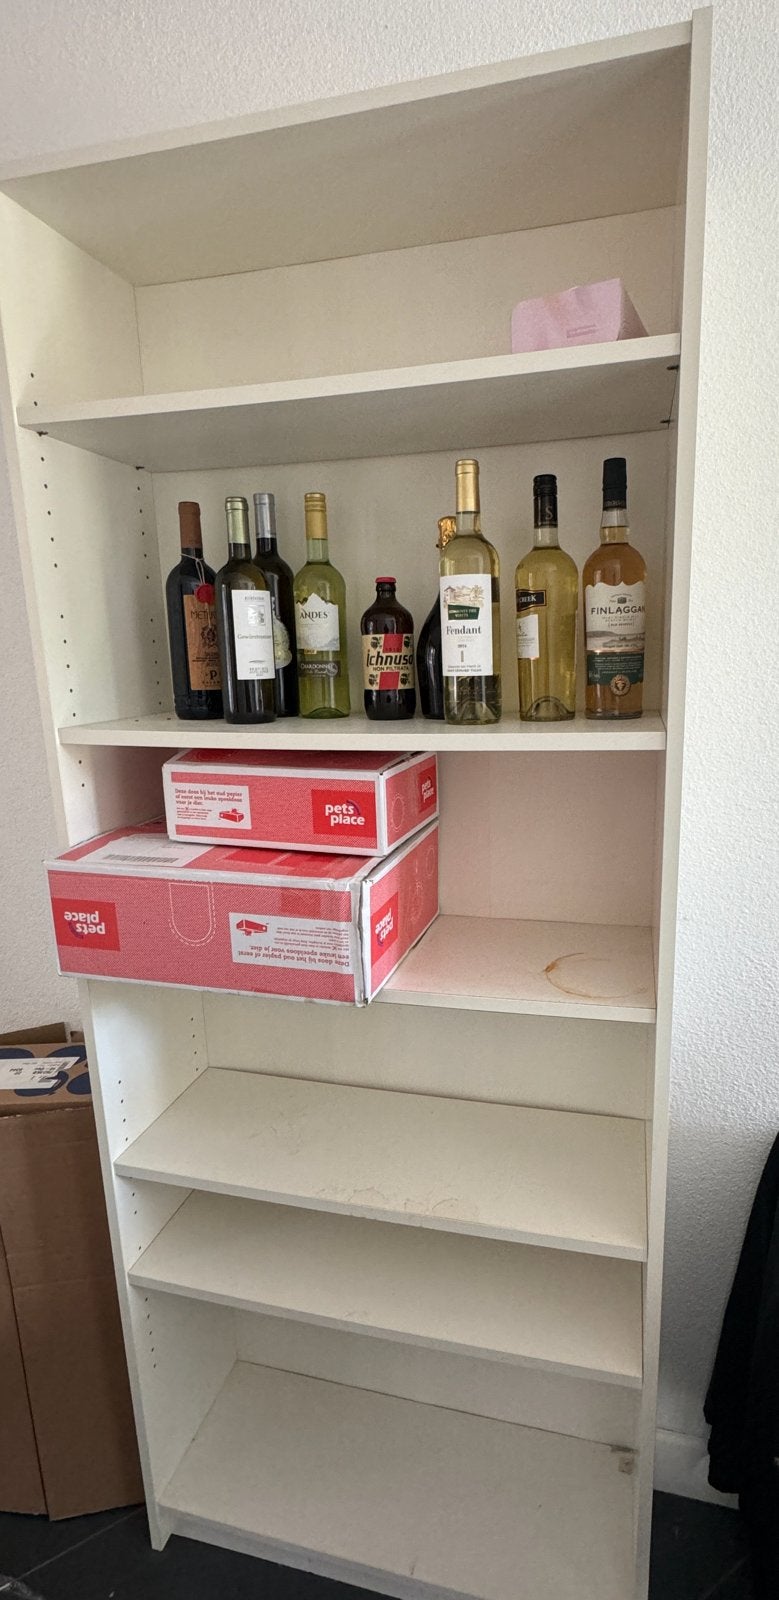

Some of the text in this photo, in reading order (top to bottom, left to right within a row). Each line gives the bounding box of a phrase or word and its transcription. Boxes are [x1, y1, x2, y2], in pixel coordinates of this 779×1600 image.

[299, 608, 329, 623] ANDES
[590, 605, 645, 616] FINLAGGAN
[446, 625, 482, 636] Fendant
[422, 779, 431, 796] pets
[325, 803, 354, 816] pets
[330, 814, 365, 827] place
[64, 911, 99, 924] place
[76, 922, 105, 934] pets
[263, 945, 270, 953] je
[286, 949, 318, 957] speeldoos
[308, 955, 317, 964] bij
[317, 958, 333, 966] doos
